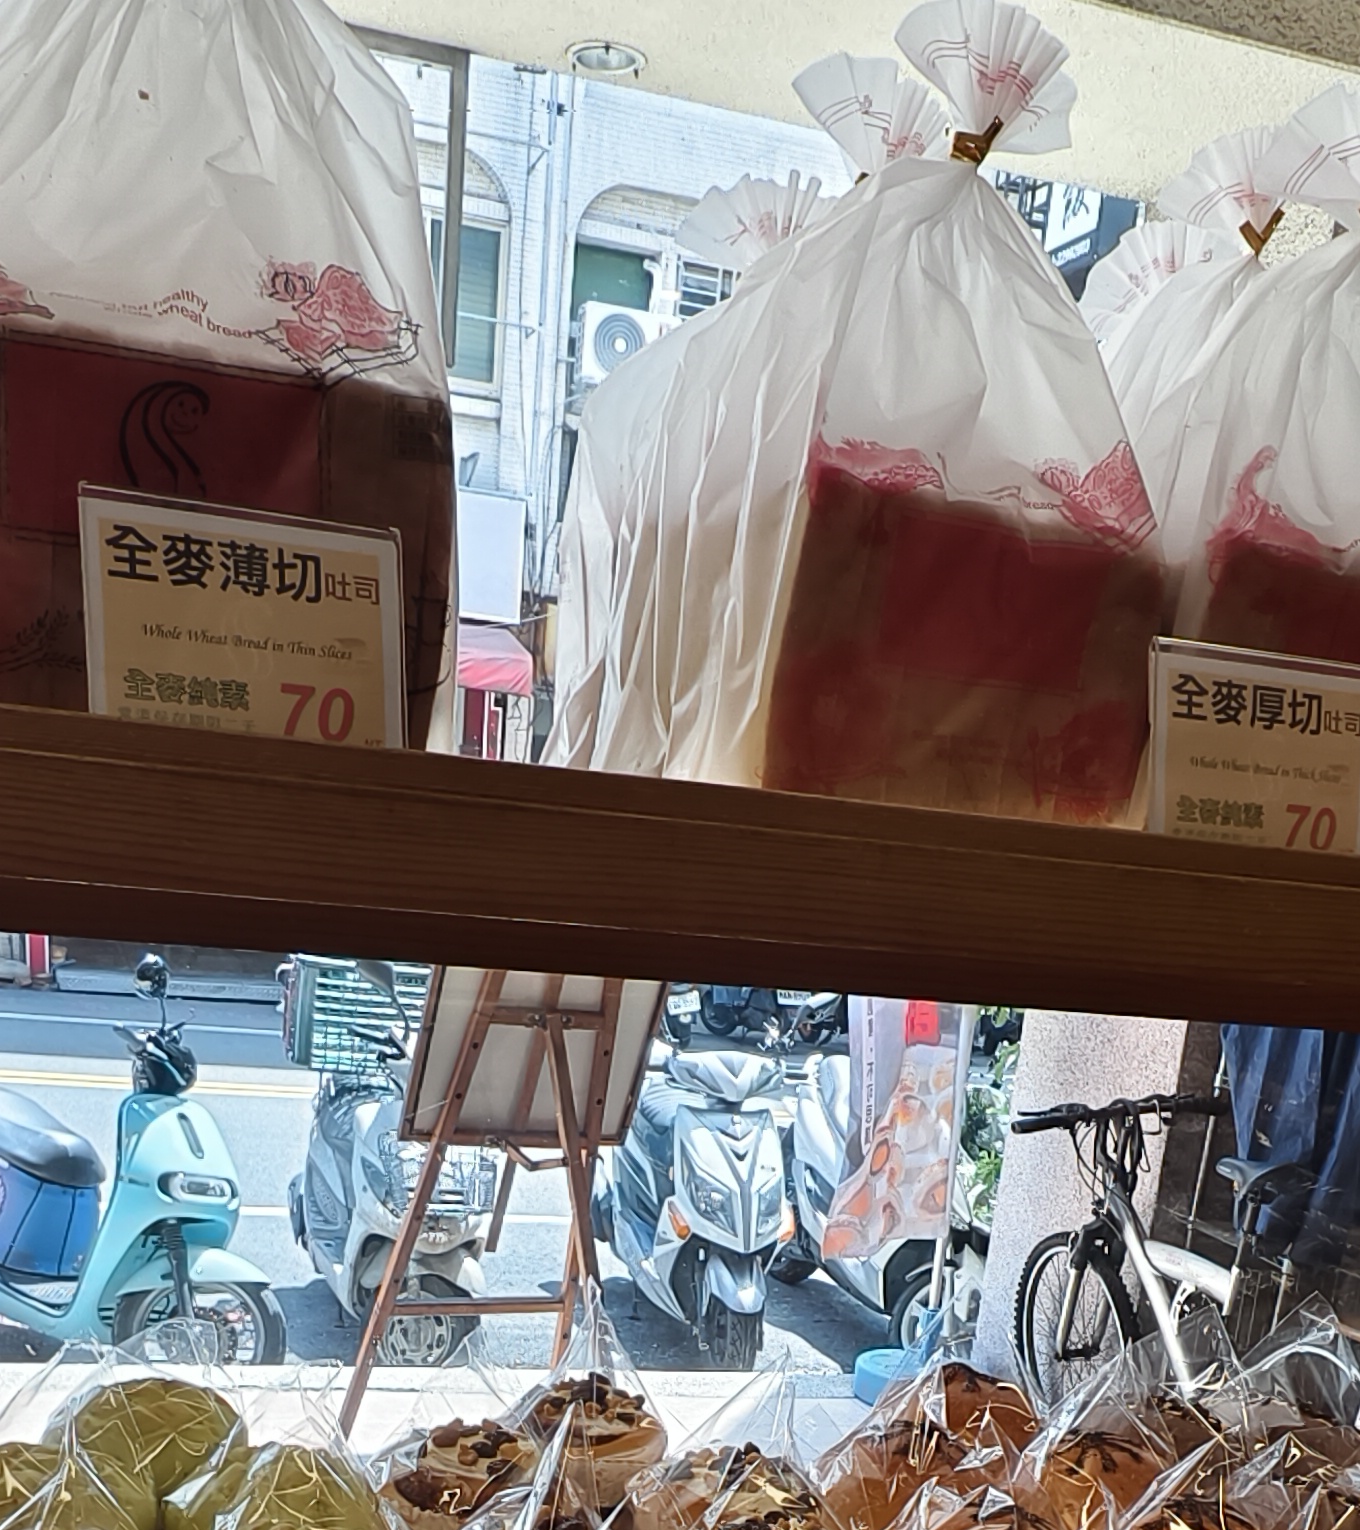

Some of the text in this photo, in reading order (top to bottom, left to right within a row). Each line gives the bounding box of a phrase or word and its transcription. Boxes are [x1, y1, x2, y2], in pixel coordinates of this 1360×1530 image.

[206, 318, 252, 338] bread
[141, 623, 182, 642] Whole
[186, 627, 228, 647] Wheat
[287, 641, 316, 657] Thin
[280, 682, 355, 743] 70
[1285, 803, 1337, 851] 70
